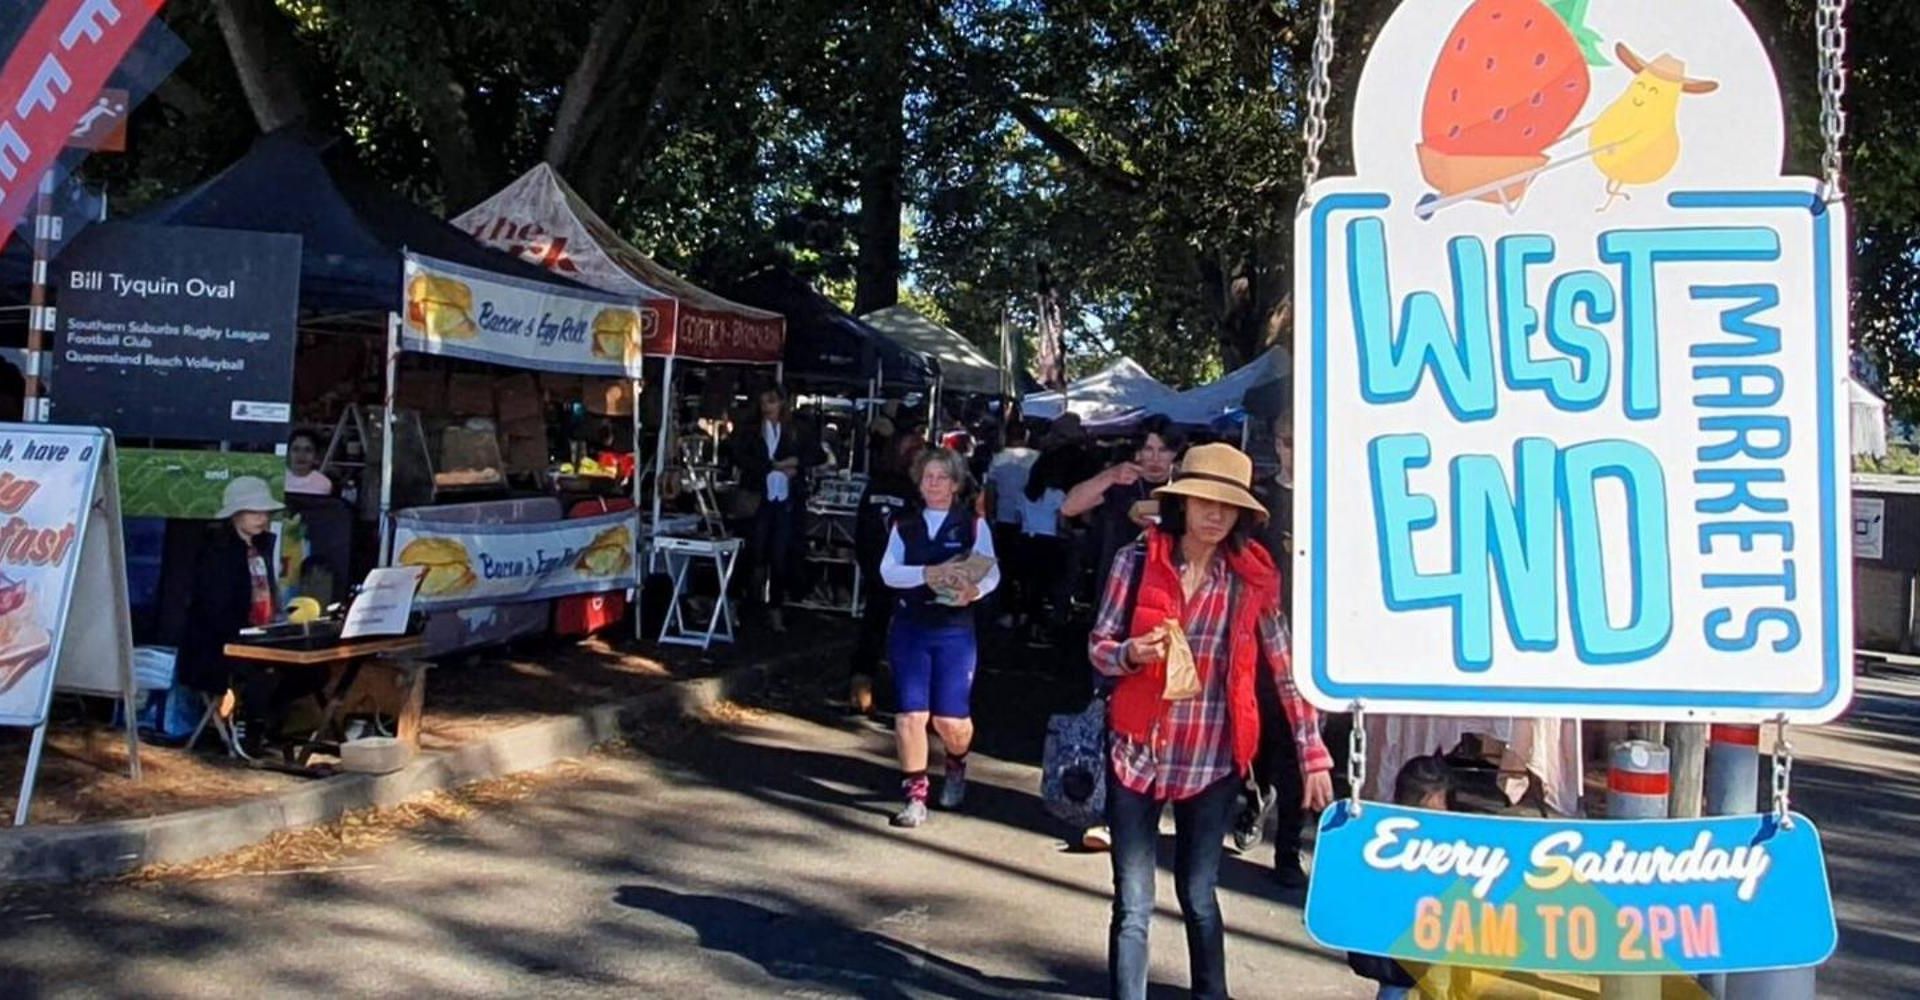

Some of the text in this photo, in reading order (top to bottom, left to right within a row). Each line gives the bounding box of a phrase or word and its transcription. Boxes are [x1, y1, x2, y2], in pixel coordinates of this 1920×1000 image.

[70, 271, 235, 299] Bill Tyquin Oval
[66, 332, 152, 348] Football Club
[67, 317, 270, 343] Southern Suburbs Rugby League
[479, 301, 523, 335] Bacon
[536, 311, 560, 347] Egg
[559, 316, 588, 343] Roll
[1346, 216, 1780, 422] WEST
[65, 349, 245, 371] Queensland Beach Volleyball
[21, 439, 69, 462] have
[79, 445, 94, 461] a
[1689, 283, 1803, 653] MARKETS
[1367, 432, 1673, 672] END
[1362, 817, 1770, 901] Every Saturday
[1413, 895, 1722, 961] 6AM TO 2PM
